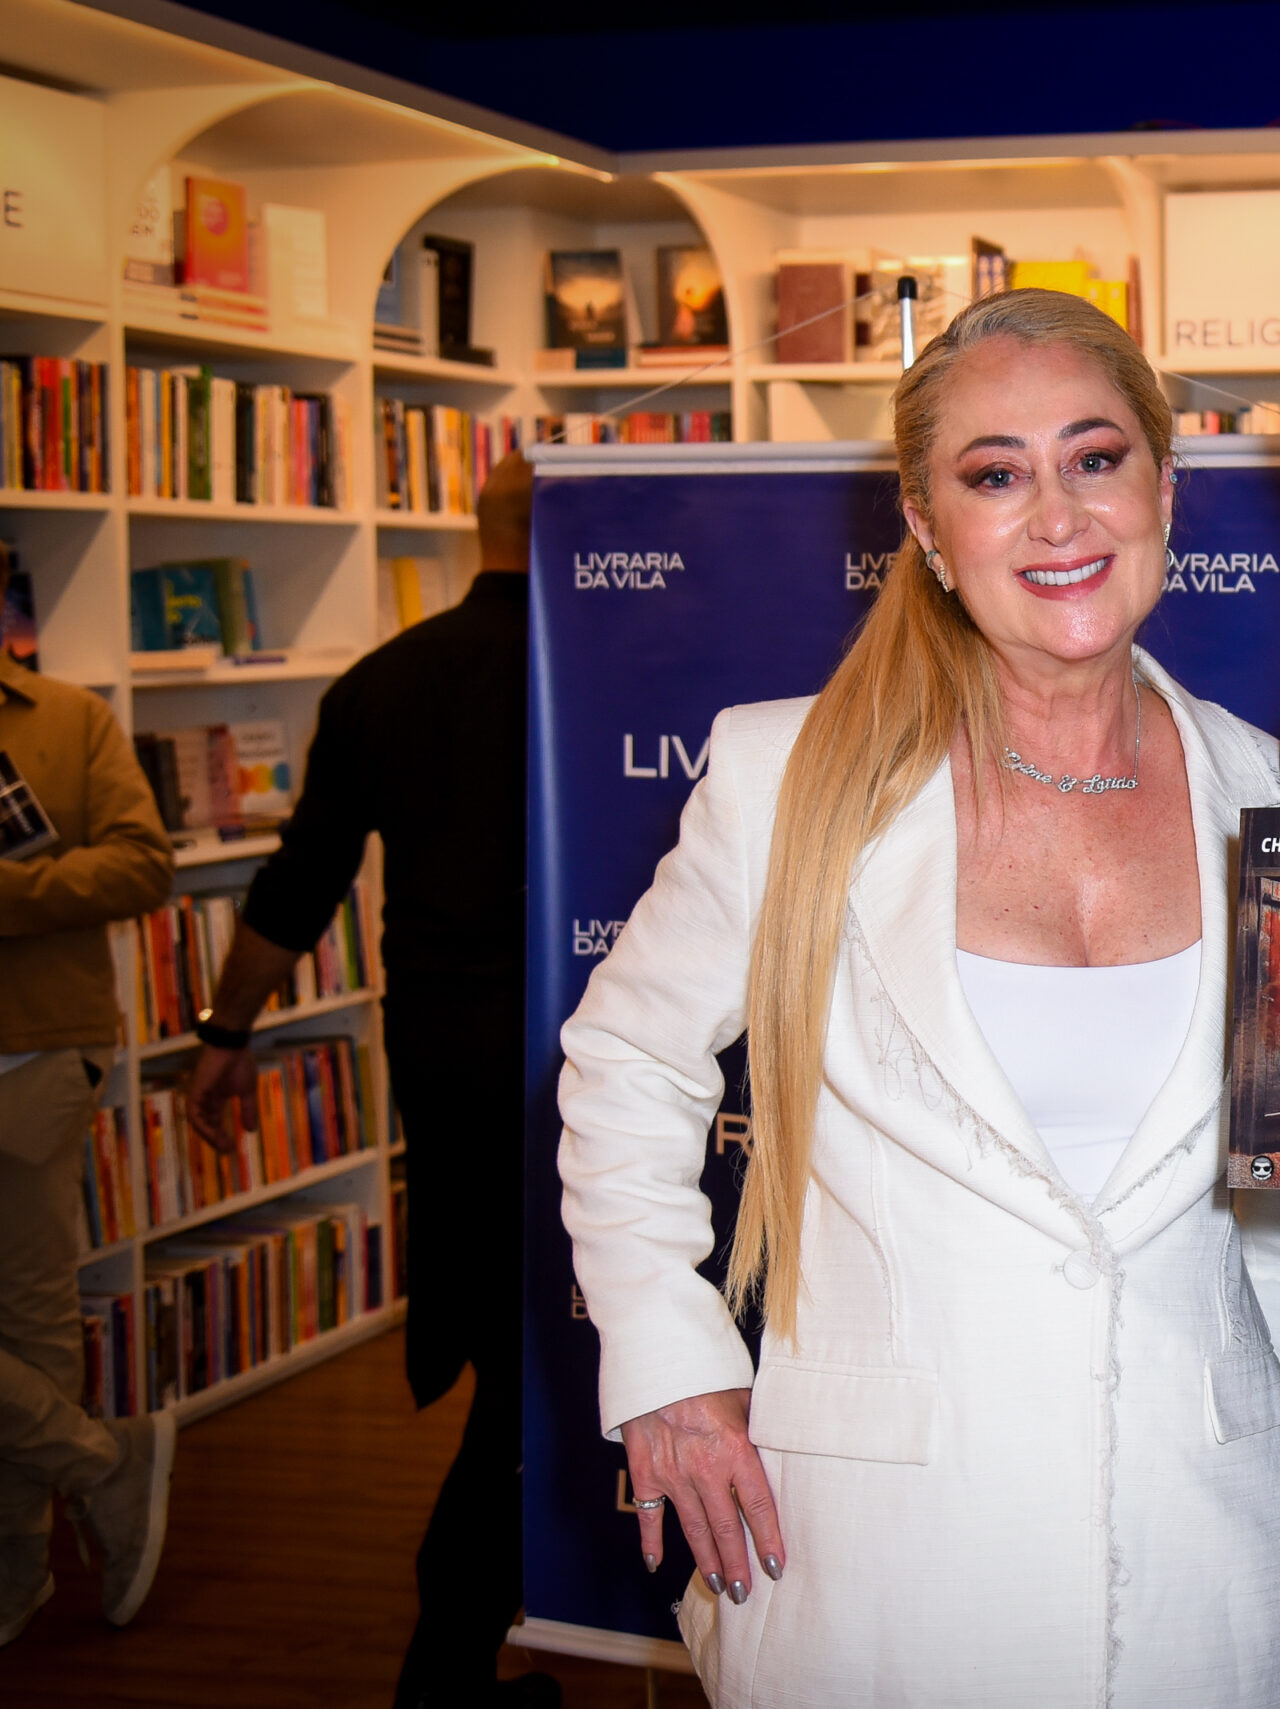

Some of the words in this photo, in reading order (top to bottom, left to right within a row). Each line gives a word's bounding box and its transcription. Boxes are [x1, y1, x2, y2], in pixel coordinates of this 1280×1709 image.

[574, 552, 685, 570] LIVRARIA
[575, 571, 609, 589] DA
[611, 571, 666, 589] VILA
[846, 572, 882, 590] DA
[1190, 573, 1256, 592] VILA
[1058, 774, 1078, 793] &
[573, 937, 610, 956] DA
